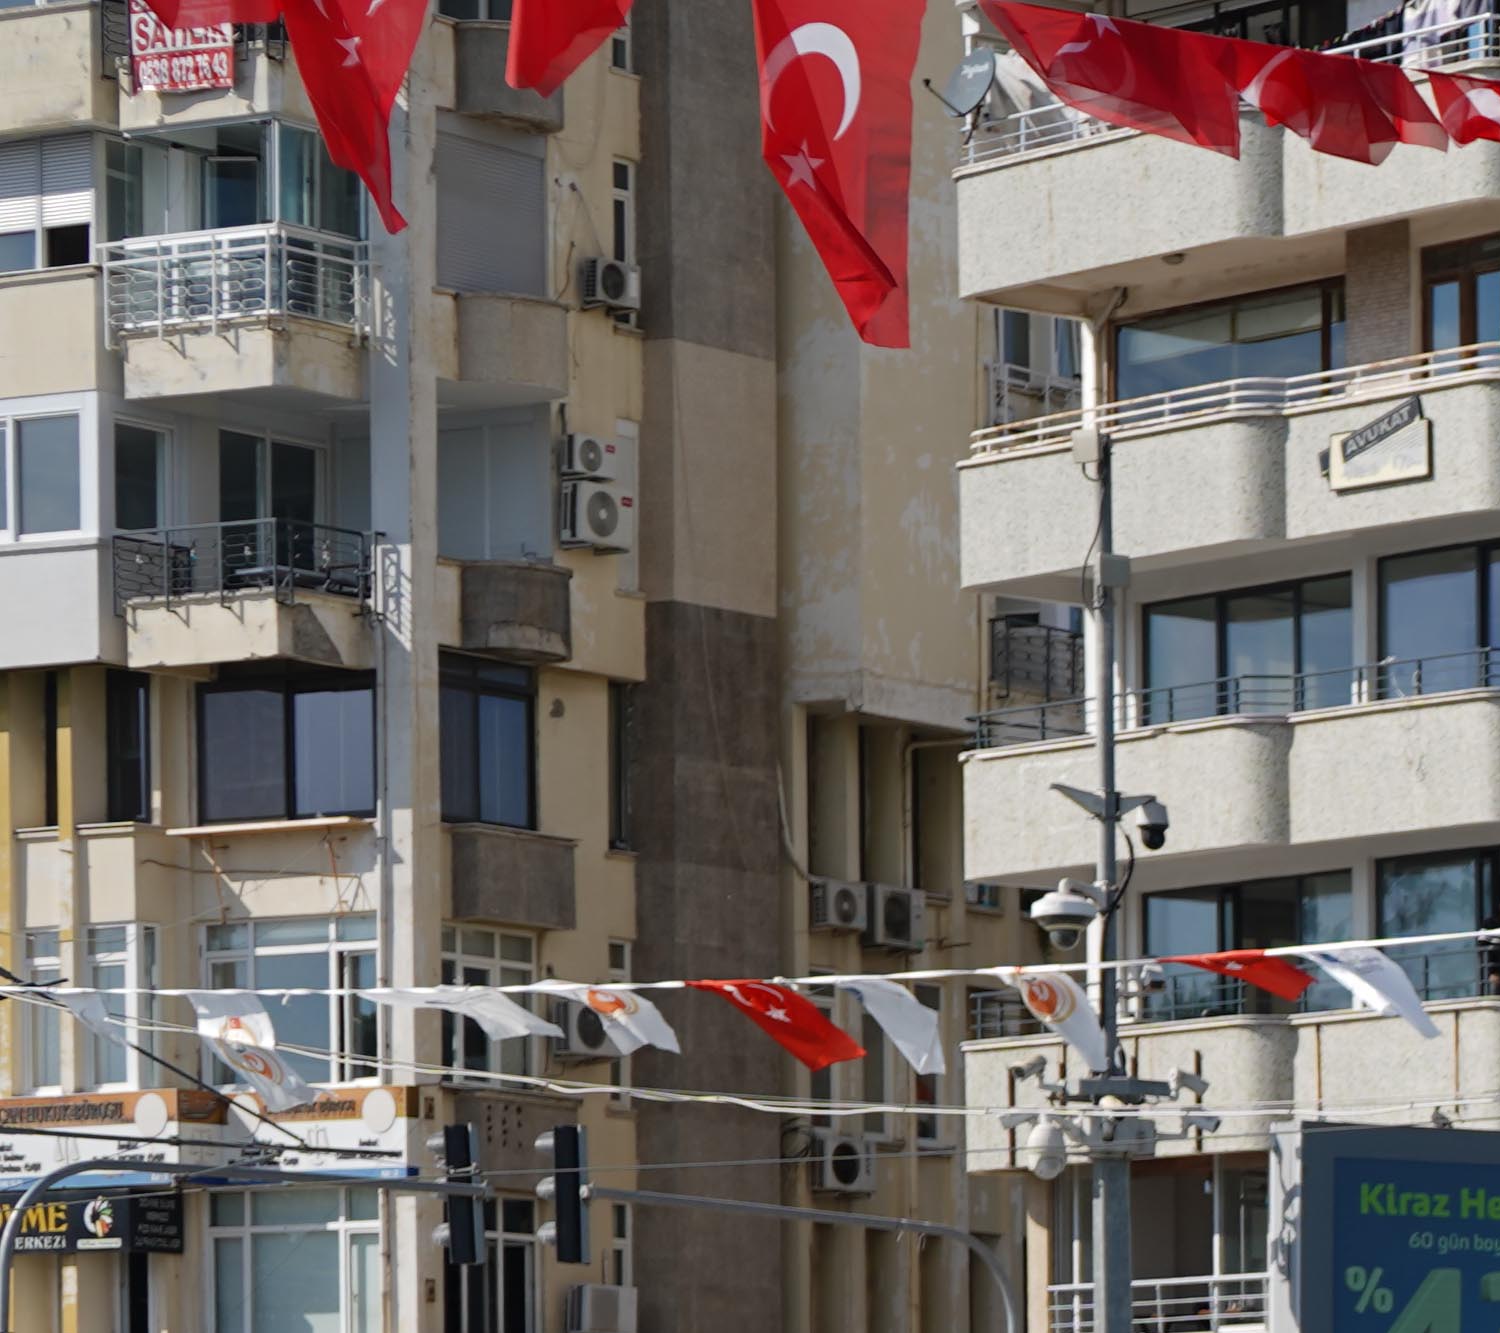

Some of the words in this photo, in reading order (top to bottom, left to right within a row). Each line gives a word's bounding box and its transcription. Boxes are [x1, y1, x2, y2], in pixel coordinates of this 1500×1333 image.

[1345, 406, 1411, 456] AVUKAT
[1360, 1183, 1450, 1218] Kiraz
[1408, 1231, 1433, 1250] 60
[1437, 1233, 1470, 1256] gün
